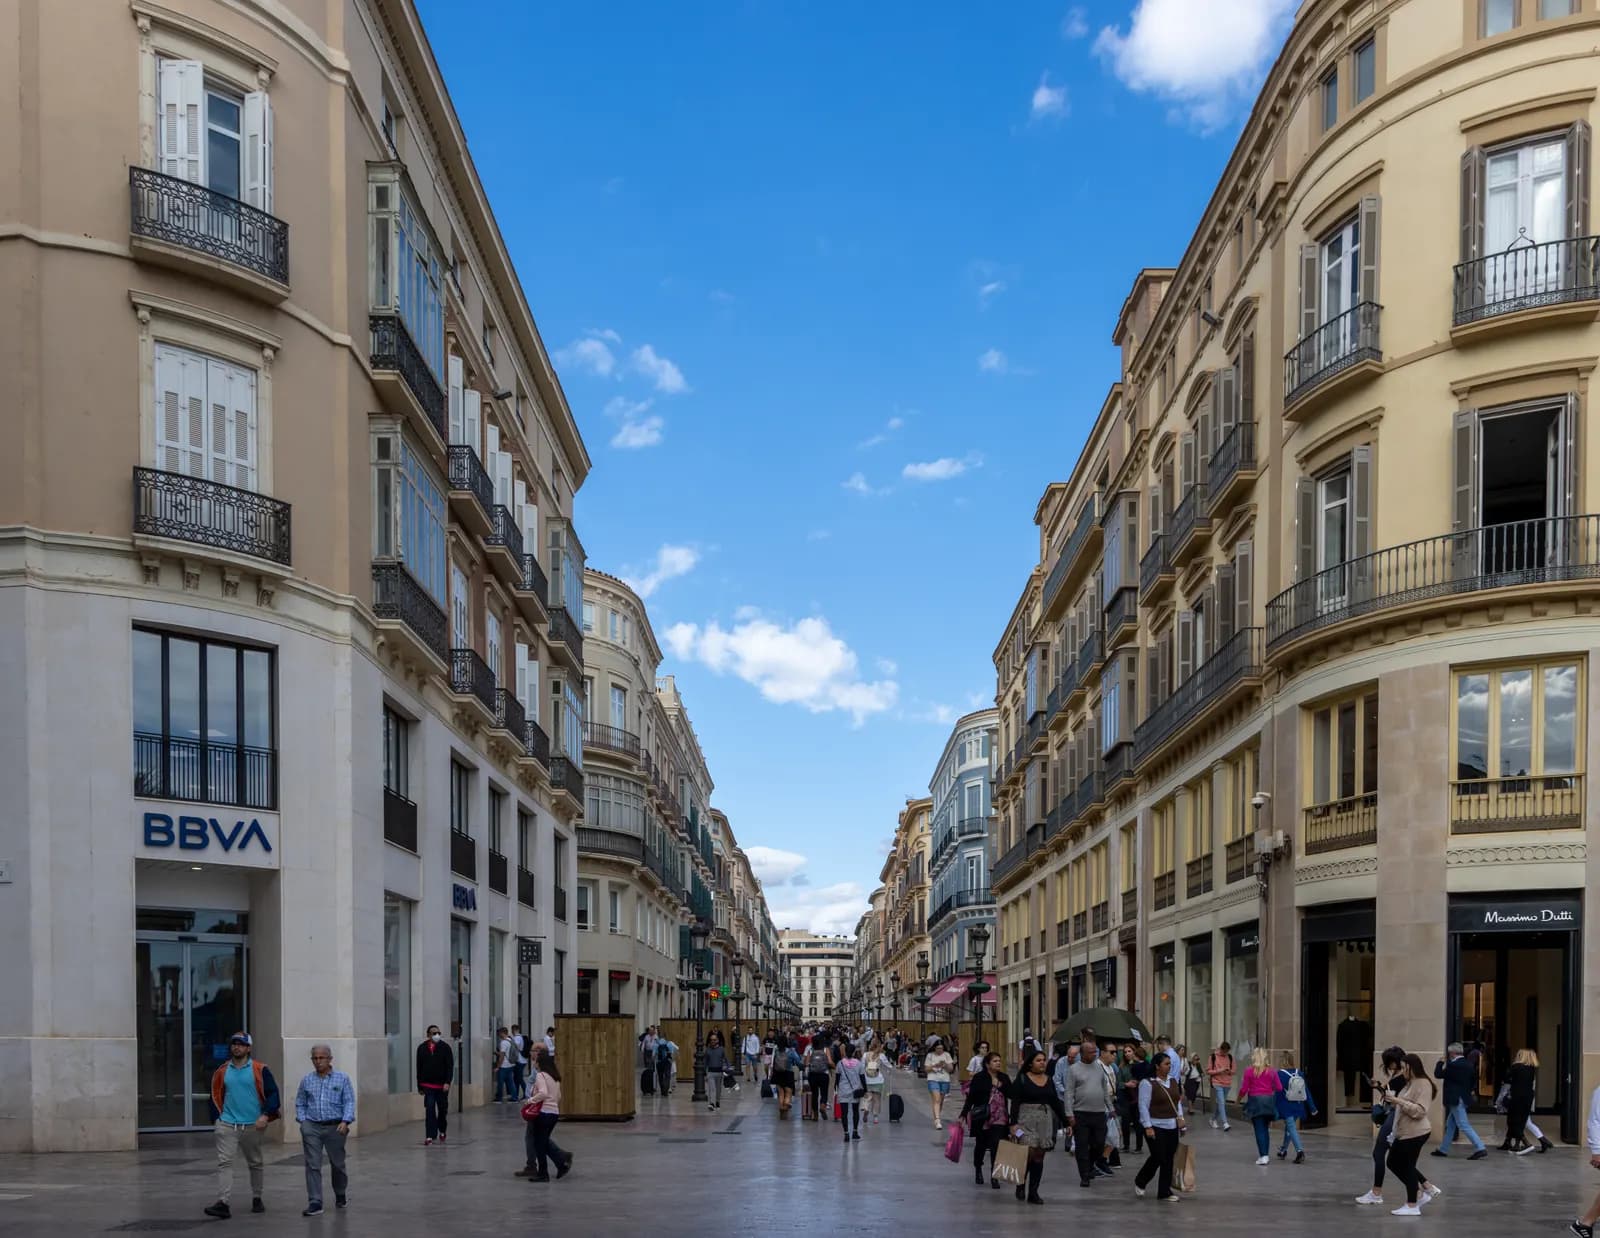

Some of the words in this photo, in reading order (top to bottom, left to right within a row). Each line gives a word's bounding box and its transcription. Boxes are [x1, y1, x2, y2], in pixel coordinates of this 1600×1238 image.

[144, 812, 273, 853] BBVA
[1484, 911, 1538, 923] Massimo
[1540, 909, 1574, 921] Dutti
